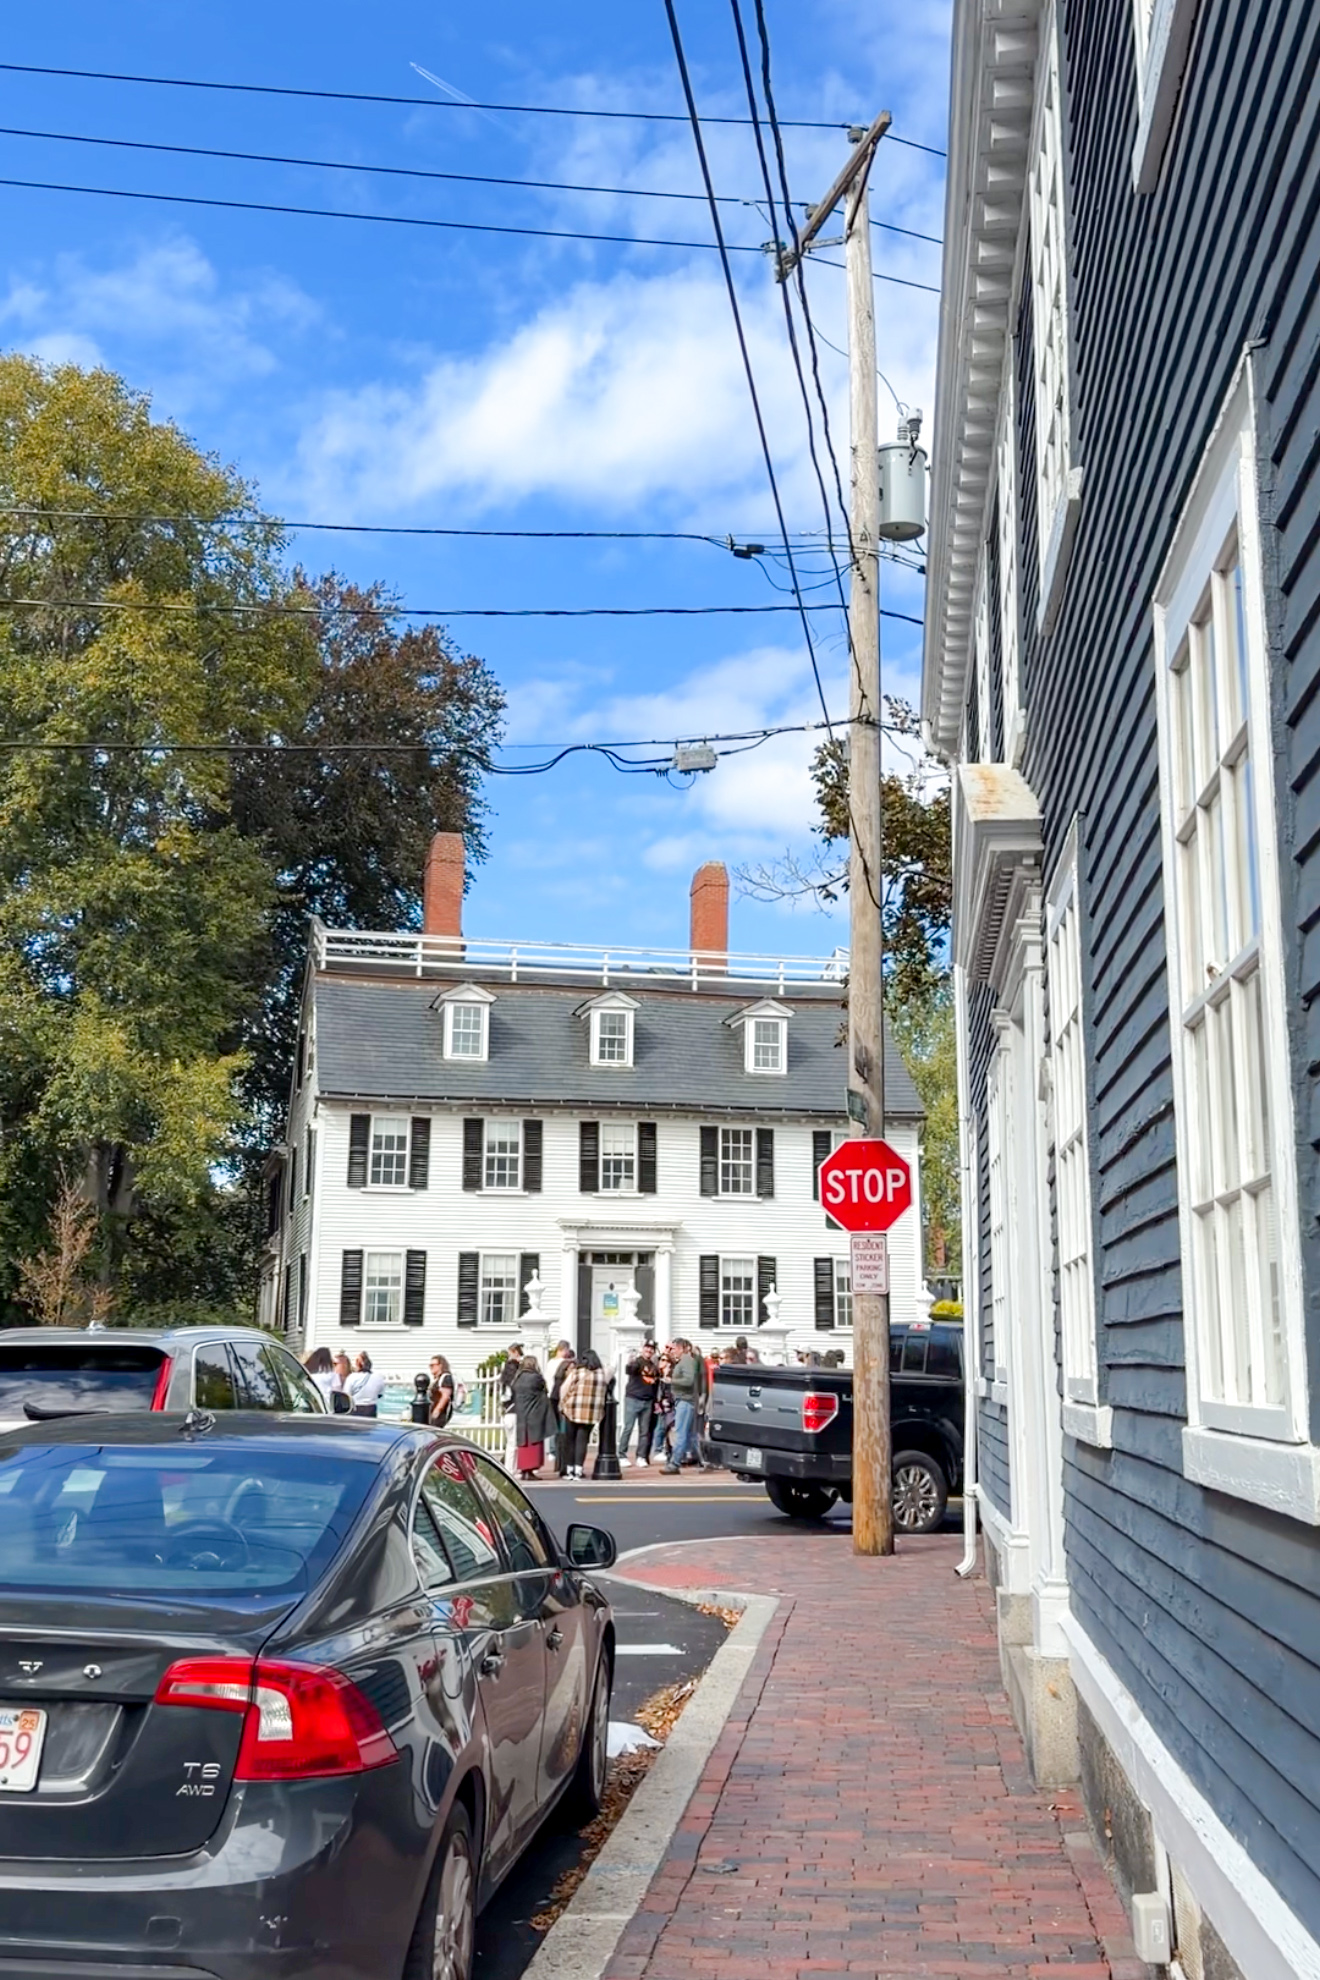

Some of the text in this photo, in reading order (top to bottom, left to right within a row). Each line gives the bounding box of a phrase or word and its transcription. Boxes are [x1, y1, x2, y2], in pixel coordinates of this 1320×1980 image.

[826, 1168, 906, 1204] STOP
[853, 1241, 883, 1249] RESIDENT
[183, 1762, 221, 1778] T6
[176, 1784, 215, 1796] AWD
